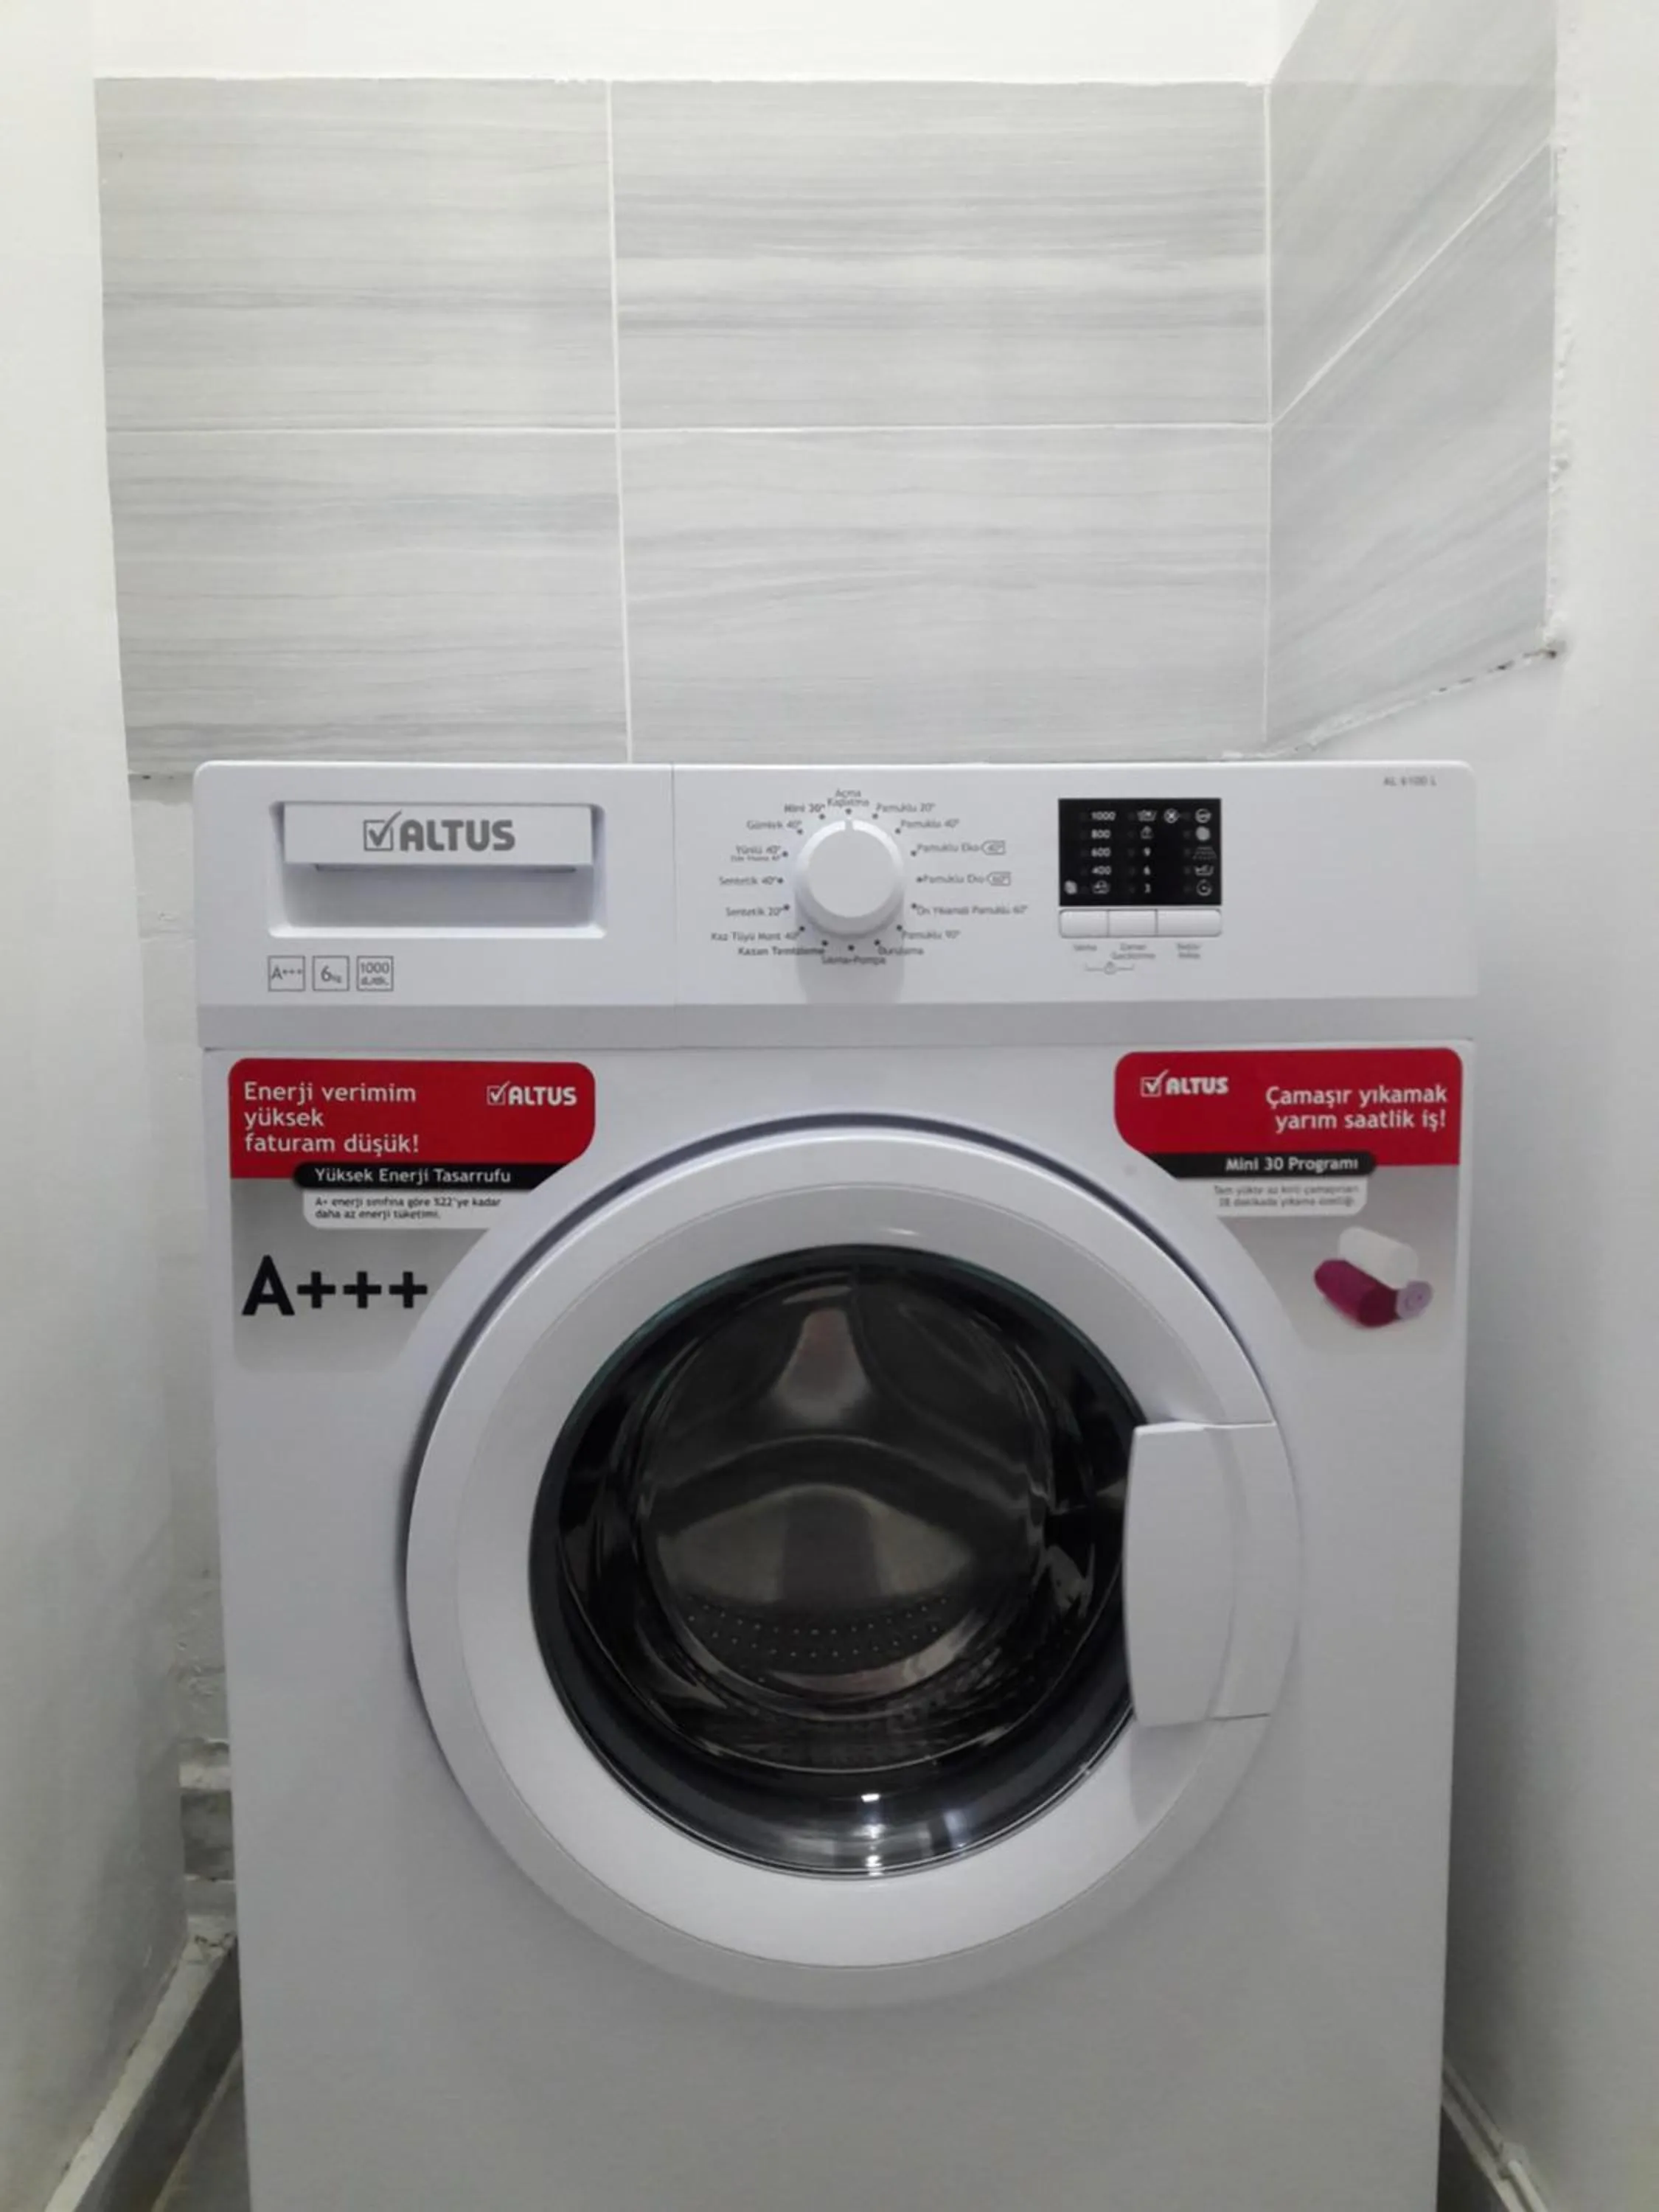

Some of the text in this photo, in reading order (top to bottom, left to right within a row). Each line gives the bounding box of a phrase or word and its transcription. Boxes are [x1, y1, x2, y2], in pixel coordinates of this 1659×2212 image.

[1091, 811, 1116, 821] 1000
[399, 819, 515, 852] ALTUS
[361, 961, 390, 974] 1000
[244, 1082, 417, 1107] Enerji verimim
[508, 1086, 577, 1105] ALTUS
[1165, 1077, 1228, 1095] ALTUS
[1265, 1085, 1447, 1109] Çamaşır yıkamak
[244, 1107, 324, 1128] yüksek
[1275, 1110, 1447, 1134] yarım saatlik iş!
[245, 1133, 419, 1157] faturam düşük!
[1225, 1158, 1358, 1174] Mini 30 Programı
[315, 1167, 511, 1186] Yüksek Enerji Tasarrufu
[472, 1197, 501, 1206] kadar
[315, 1210, 341, 1219] daha
[242, 1255, 428, 1316] A+++
